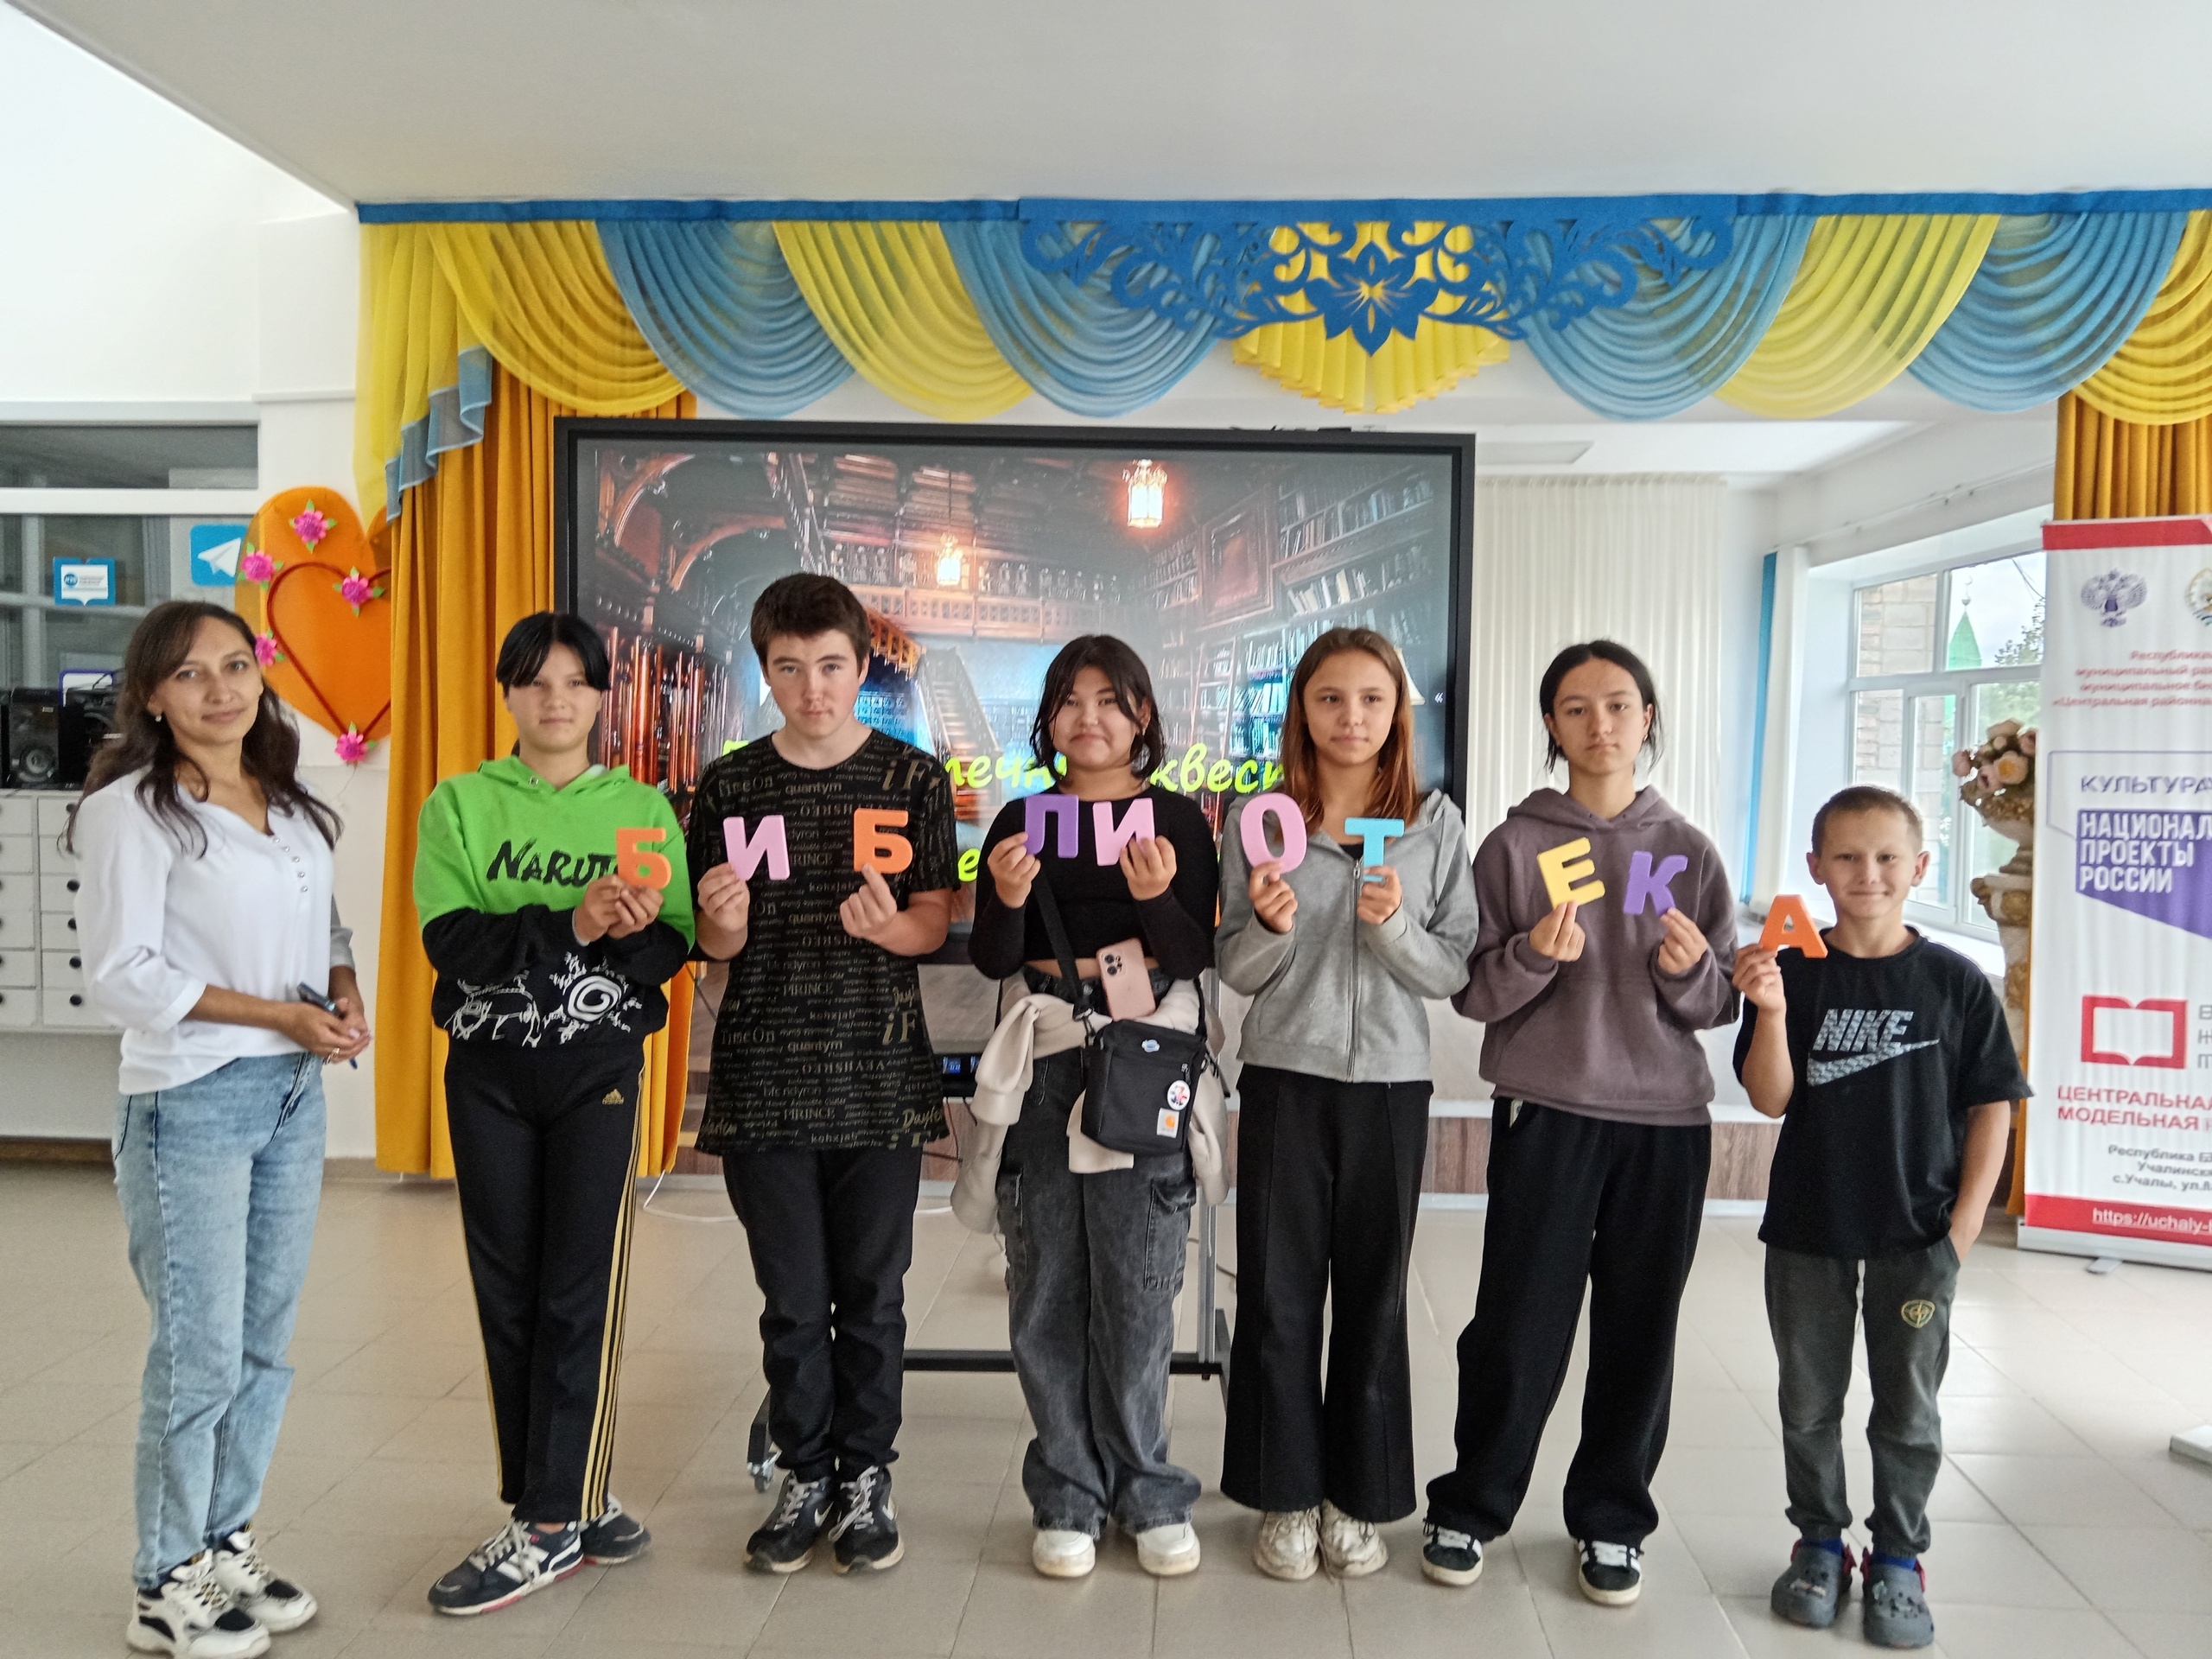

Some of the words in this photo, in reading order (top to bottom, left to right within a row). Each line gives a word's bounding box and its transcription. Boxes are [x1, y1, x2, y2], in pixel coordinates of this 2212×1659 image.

[486, 836, 617, 887] NARUT
[2080, 839, 2194, 868] ПРОЕКТЫ
[2079, 866, 2173, 893] РОССИИ
[1813, 1008, 1914, 1052] NIKE
[2057, 1106, 2199, 1130] МОДЕЛЬНАЯ
[2107, 1144, 2195, 1161] Республика
